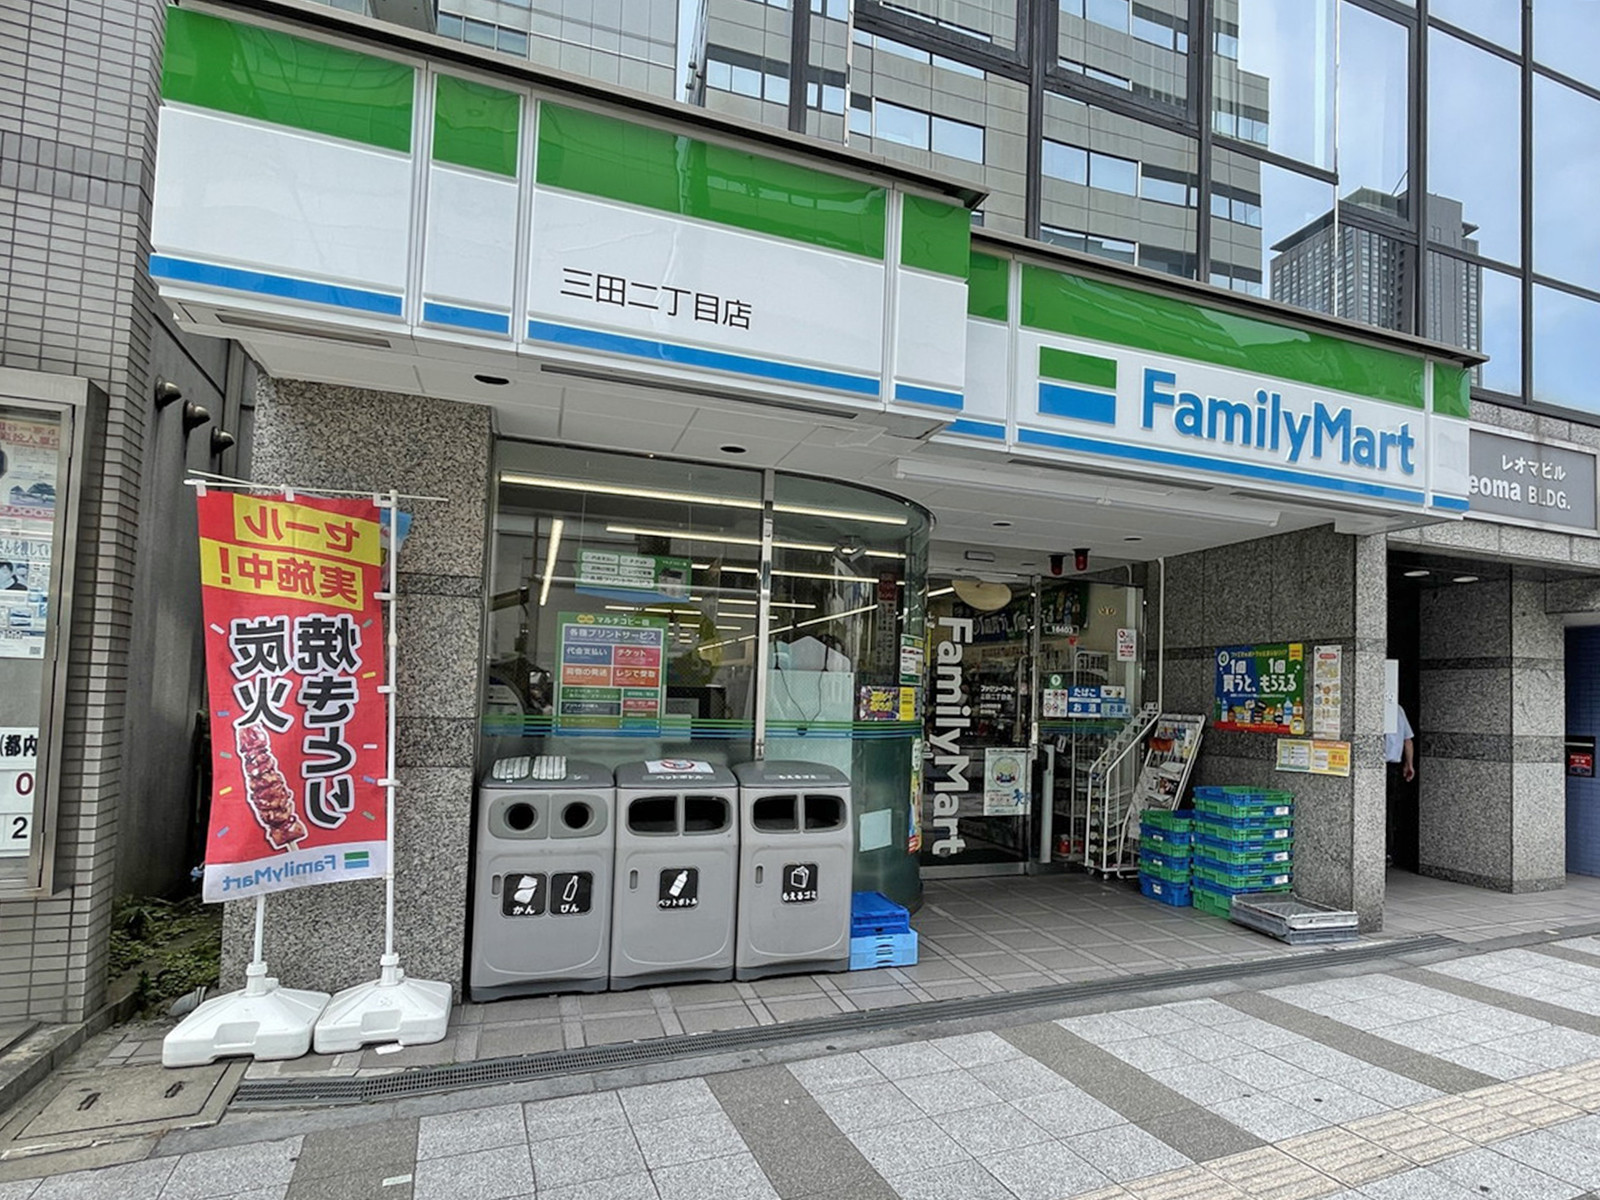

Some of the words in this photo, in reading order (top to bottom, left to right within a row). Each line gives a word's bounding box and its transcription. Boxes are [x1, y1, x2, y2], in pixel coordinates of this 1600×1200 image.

[560, 267, 752, 330] 三田二丁目店
[1140, 367, 1415, 474] FamilyMart
[1501, 454, 1566, 481] レオマビル
[1528, 485, 1571, 510] BLDG.
[1073, 687, 1097, 698] たばこ
[1260, 673, 1297, 693] もらえる
[929, 616, 974, 857] FamilyMart
[16, 772, 34, 795] 0
[12, 816, 28, 839] 2
[512, 904, 536, 915] かん
[560, 903, 580, 914] びん
[659, 898, 698, 907] ペットボトル
